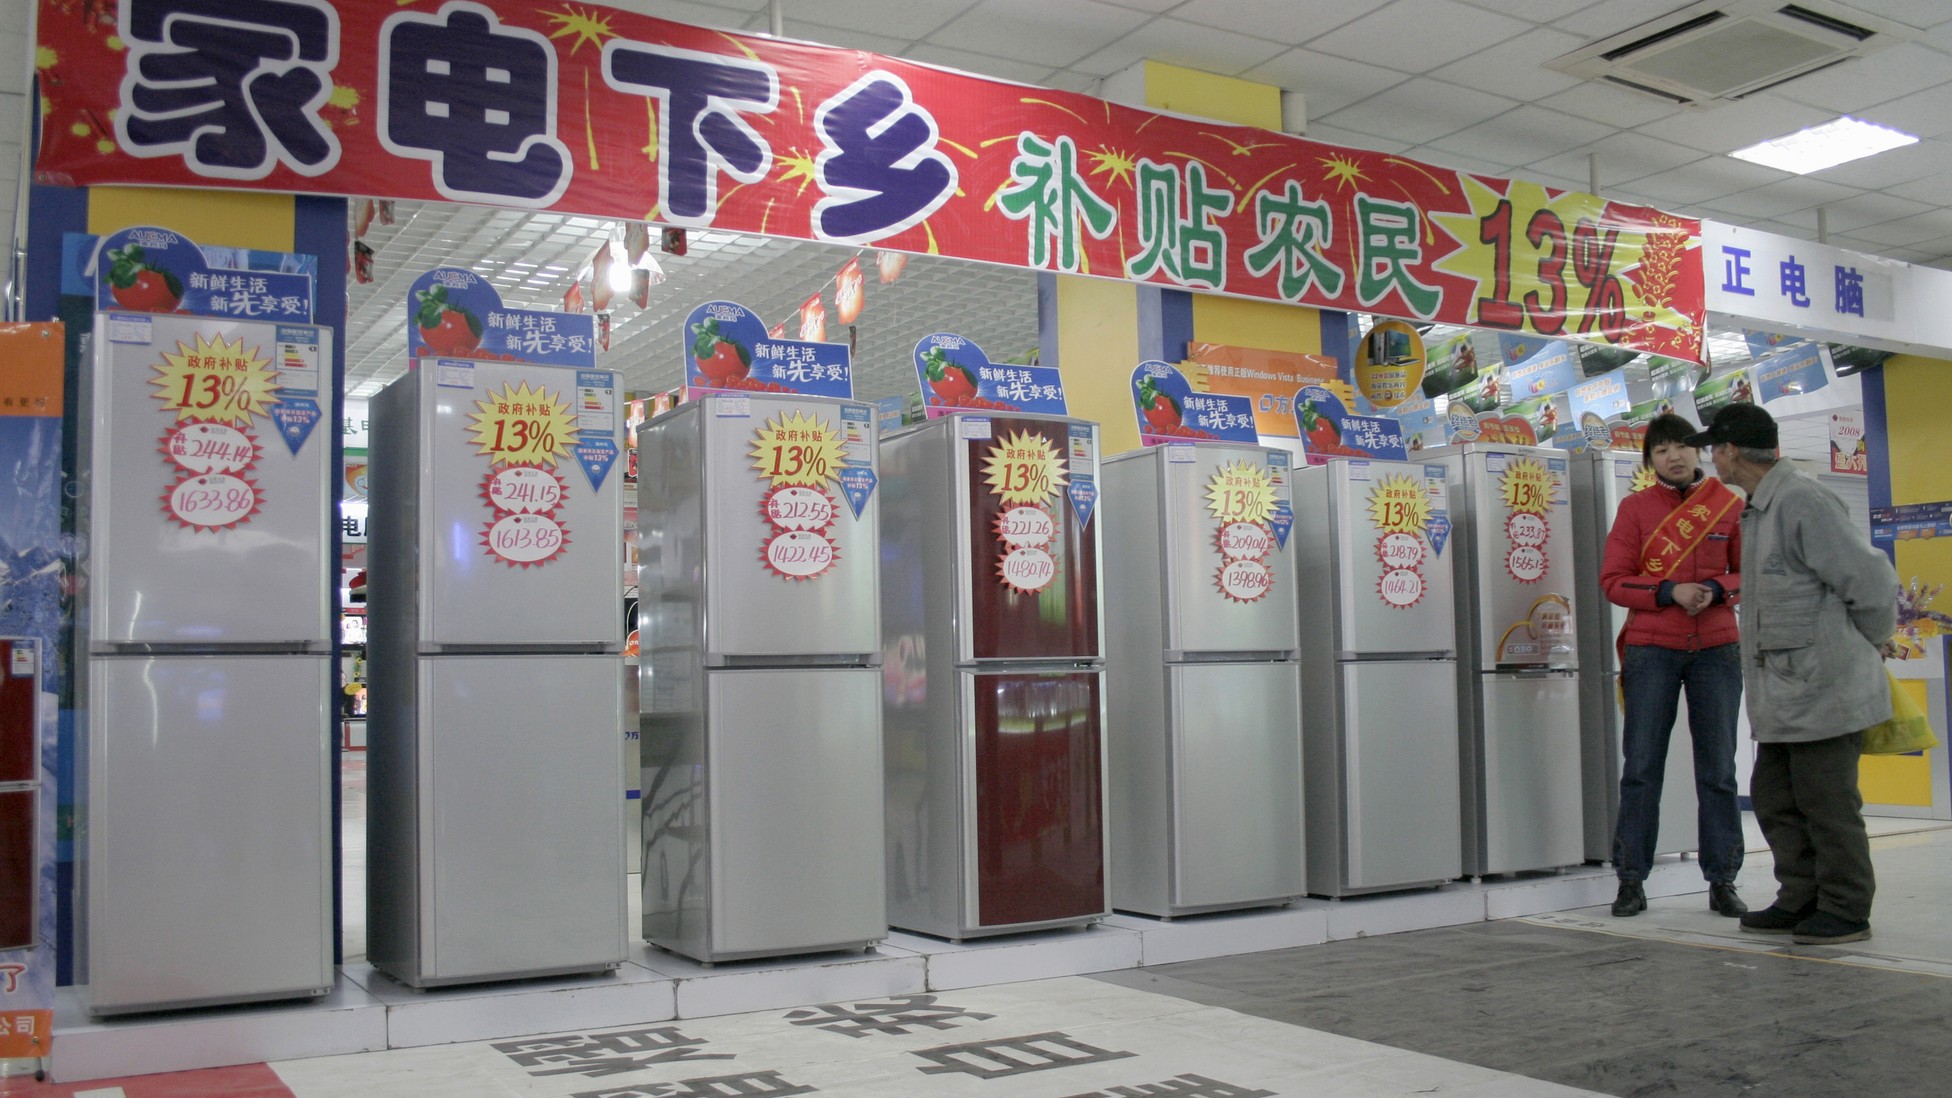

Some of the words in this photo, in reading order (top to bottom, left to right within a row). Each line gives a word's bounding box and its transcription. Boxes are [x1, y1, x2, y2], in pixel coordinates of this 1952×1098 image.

[115, 0, 958, 245] 家电下乡
[995, 131, 1443, 318] 补贴农民
[1477, 199, 1626, 342] 13%
[189, 271, 268, 293] 新鲜生活
[1721, 245, 1865, 318] 正电脑
[706, 304, 745, 318] AUCMA
[488, 311, 556, 332] 新鲜生活
[755, 343, 816, 362] 新鲜生活
[188, 355, 248, 372] 政府补贴
[979, 366, 1032, 384] 新鲜生活
[1278, 372, 1294, 382] Vista
[176, 373, 251, 411] 13%
[498, 403, 551, 416] 政府补贴
[1183, 396, 1228, 412] 新鲜生活
[490, 419, 555, 453] 13%
[776, 430, 823, 442] 政府补贴
[1839, 426, 1861, 437] 2008
[770, 445, 826, 476] 13%
[1006, 449, 1046, 460] 政府补贴
[1001, 464, 1049, 492] 13%
[1226, 476, 1260, 488] 政府补贴
[504, 482, 557, 502] 241.15
[1386, 489, 1416, 499] 政府补贴
[1511, 483, 1543, 508] 13%
[783, 502, 829, 520] 212.55
[1221, 489, 1263, 517] 13%
[1382, 502, 1419, 527] 13%
[497, 528, 559, 549] 1613.85
[1645, 503, 1711, 572] 家电下乡
[773, 545, 830, 563] 1422.45
[0, 1015, 35, 1036] 公司
